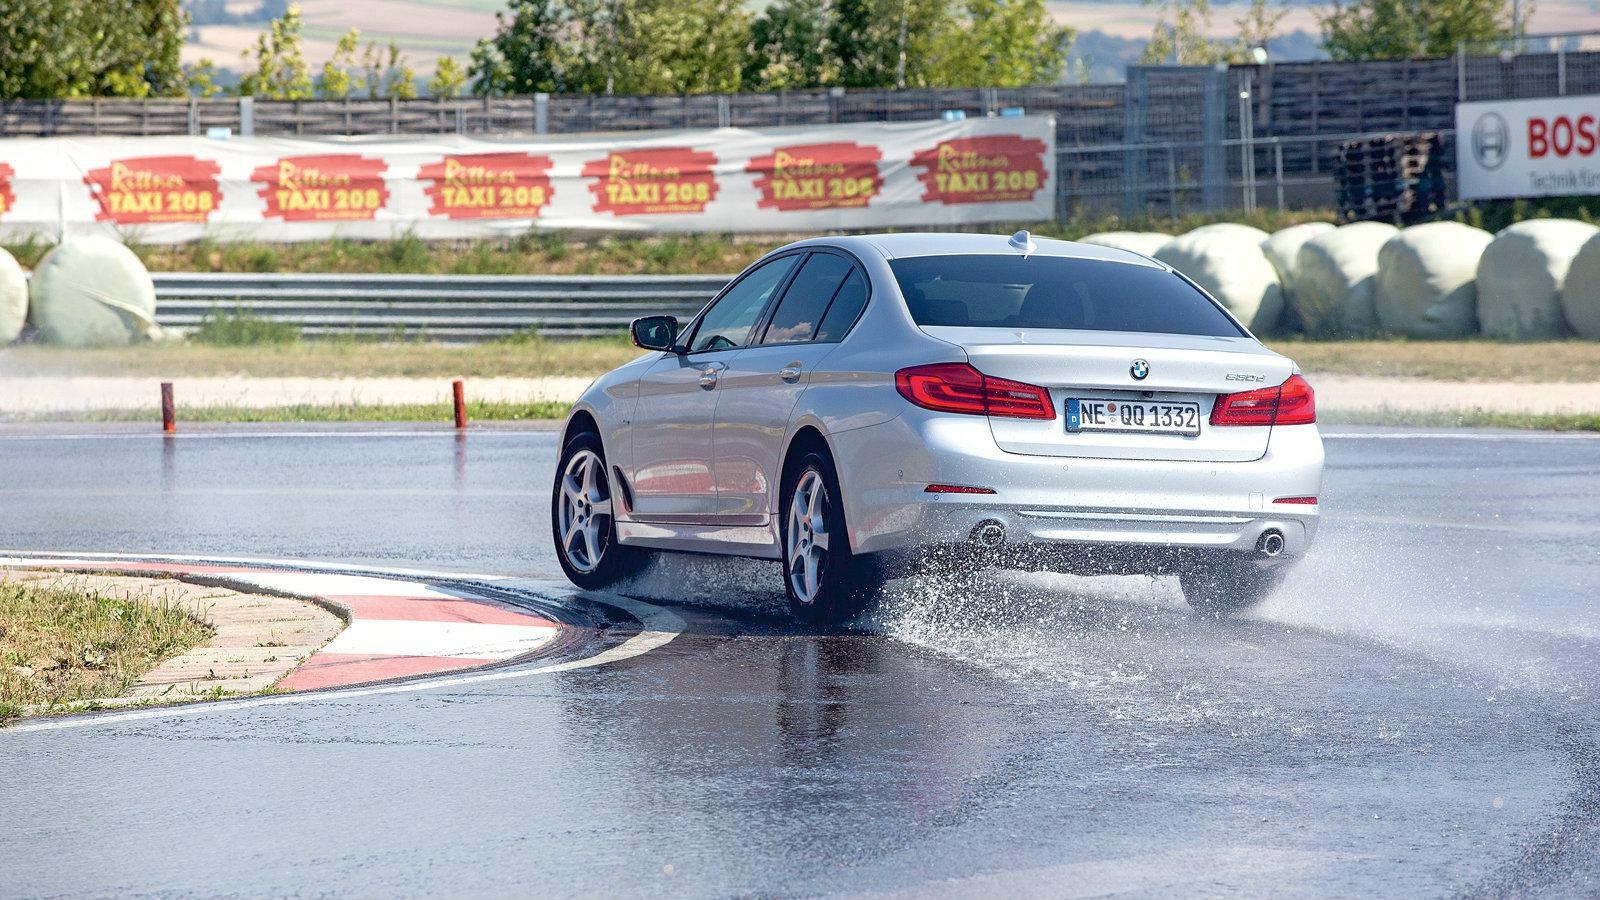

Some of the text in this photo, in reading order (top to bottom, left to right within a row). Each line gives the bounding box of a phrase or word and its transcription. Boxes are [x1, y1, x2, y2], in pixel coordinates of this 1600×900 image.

[1527, 114, 1600, 158] BOS
[771, 179, 824, 200] TAXI
[935, 169, 1038, 193] TAXI 208
[108, 190, 213, 213] TAXI 208
[275, 188, 380, 210] TAXI 208
[441, 185, 546, 208] TAXI 208
[606, 181, 710, 205] TAXI 208
[1071, 403, 1196, 428] D NE QQ 1332
